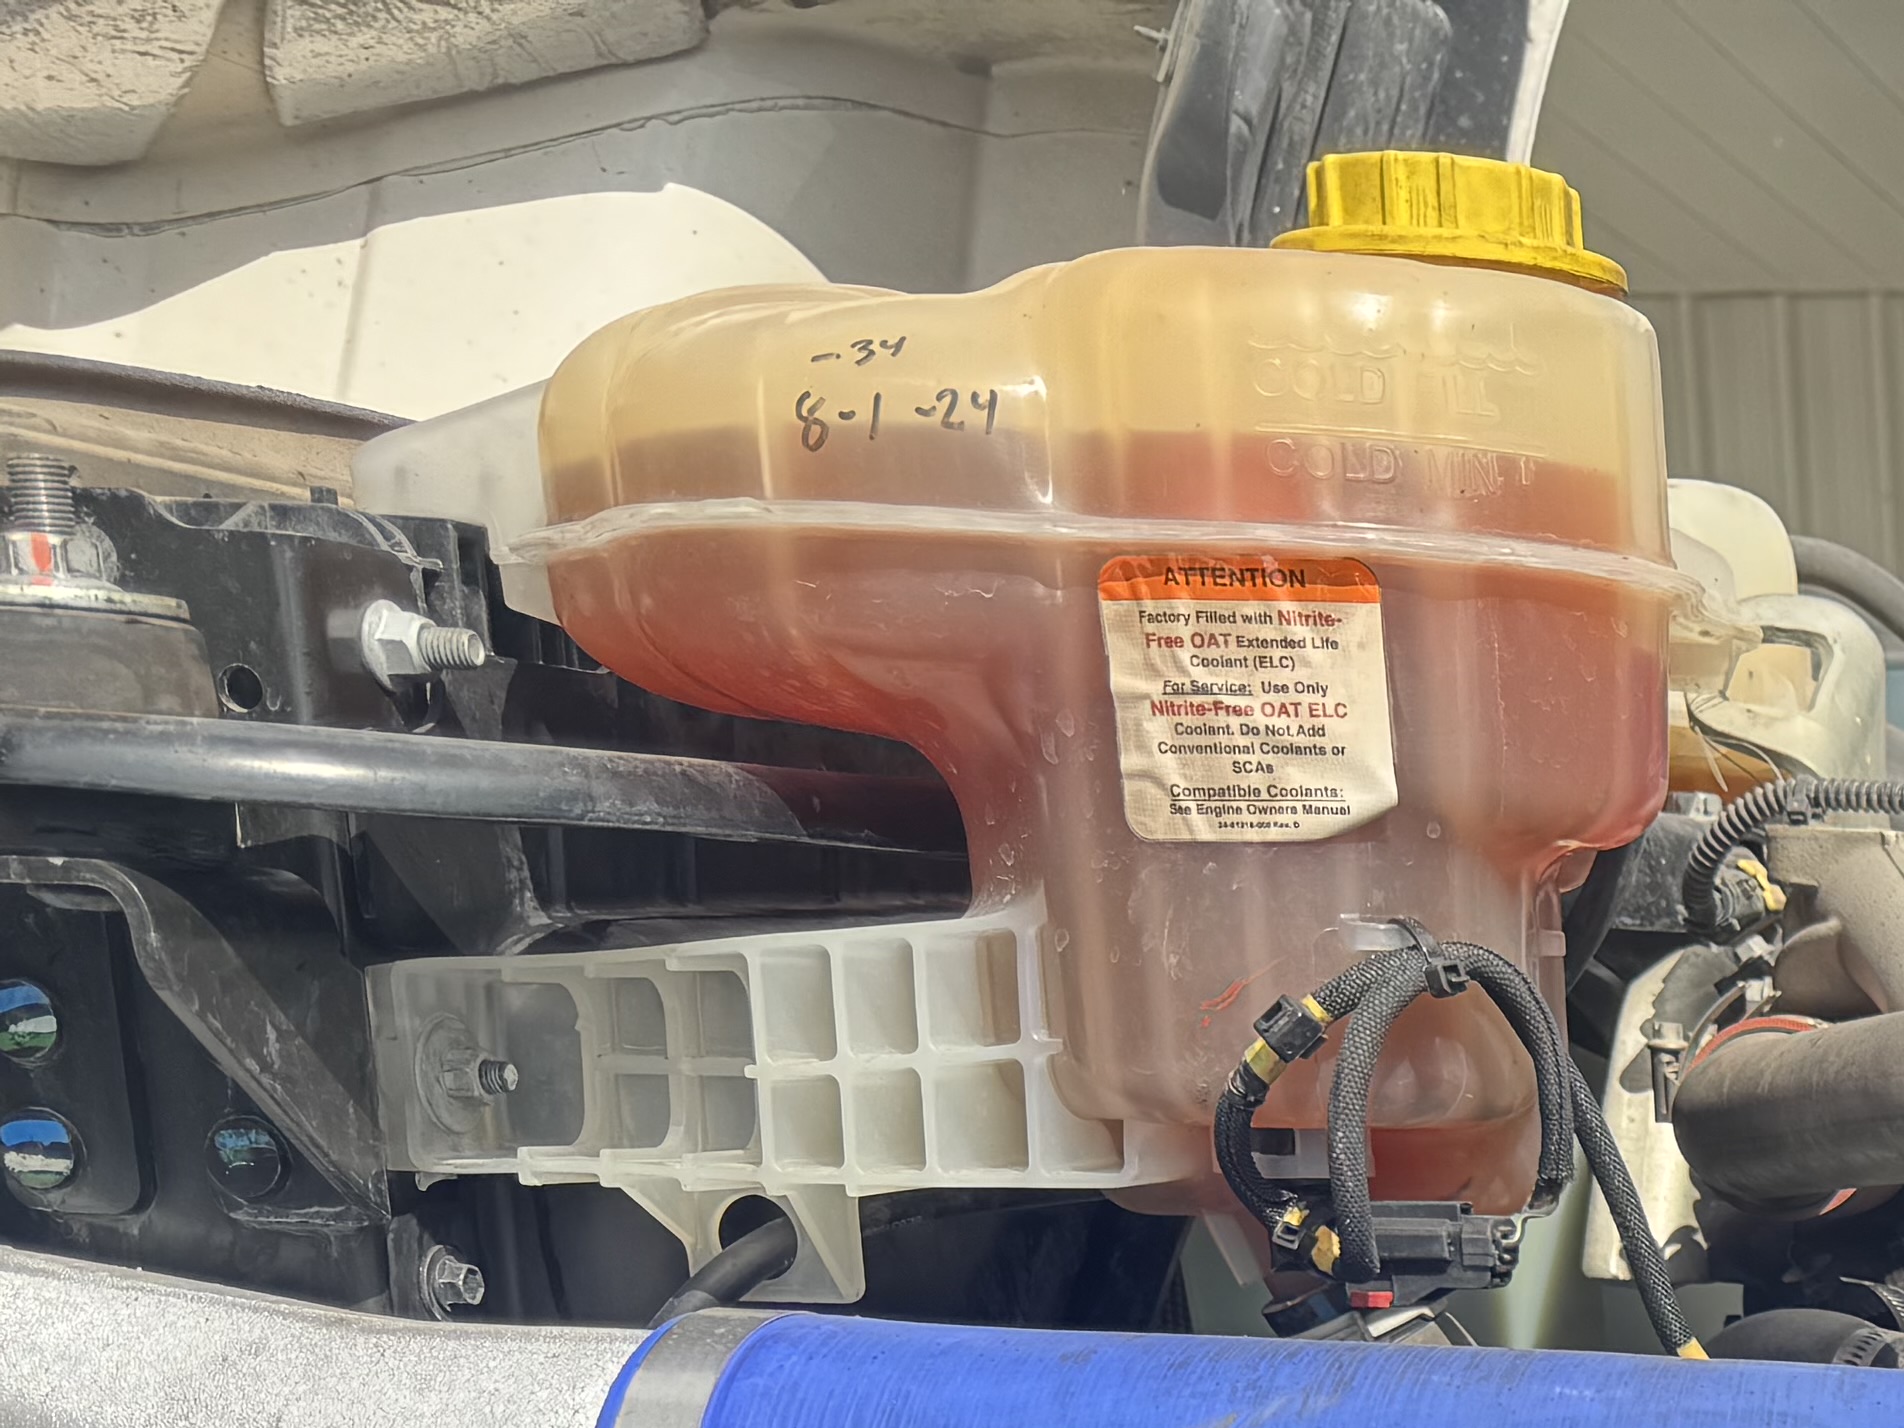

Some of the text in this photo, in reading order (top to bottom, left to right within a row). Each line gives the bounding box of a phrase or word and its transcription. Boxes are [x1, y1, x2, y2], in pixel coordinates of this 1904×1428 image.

[1254, 359, 1386, 404] COLD
[1266, 438, 1396, 483] COLD
[1163, 567, 1306, 588] ATTENTION
[1138, 610, 1342, 626] Factory Filled with Nitrite-
[1145, 633, 1338, 650] Free OAT Extended Life
[1190, 655, 1295, 671] Coolant (ELC)
[1163, 681, 1328, 697] For Service: Use Only
[1150, 701, 1347, 718] Nitrite-Free OAT ELC
[1175, 723, 1234, 736] Coolant.
[1240, 724, 1259, 736] Do
[1296, 725, 1325, 737] Add
[1158, 742, 1346, 756] Conventional Coolants or
[1232, 762, 1273, 774] SCAs
[1170, 786, 1344, 800] Compatible Coolants:
[1170, 804, 1350, 818] See Engine Owners Manual
